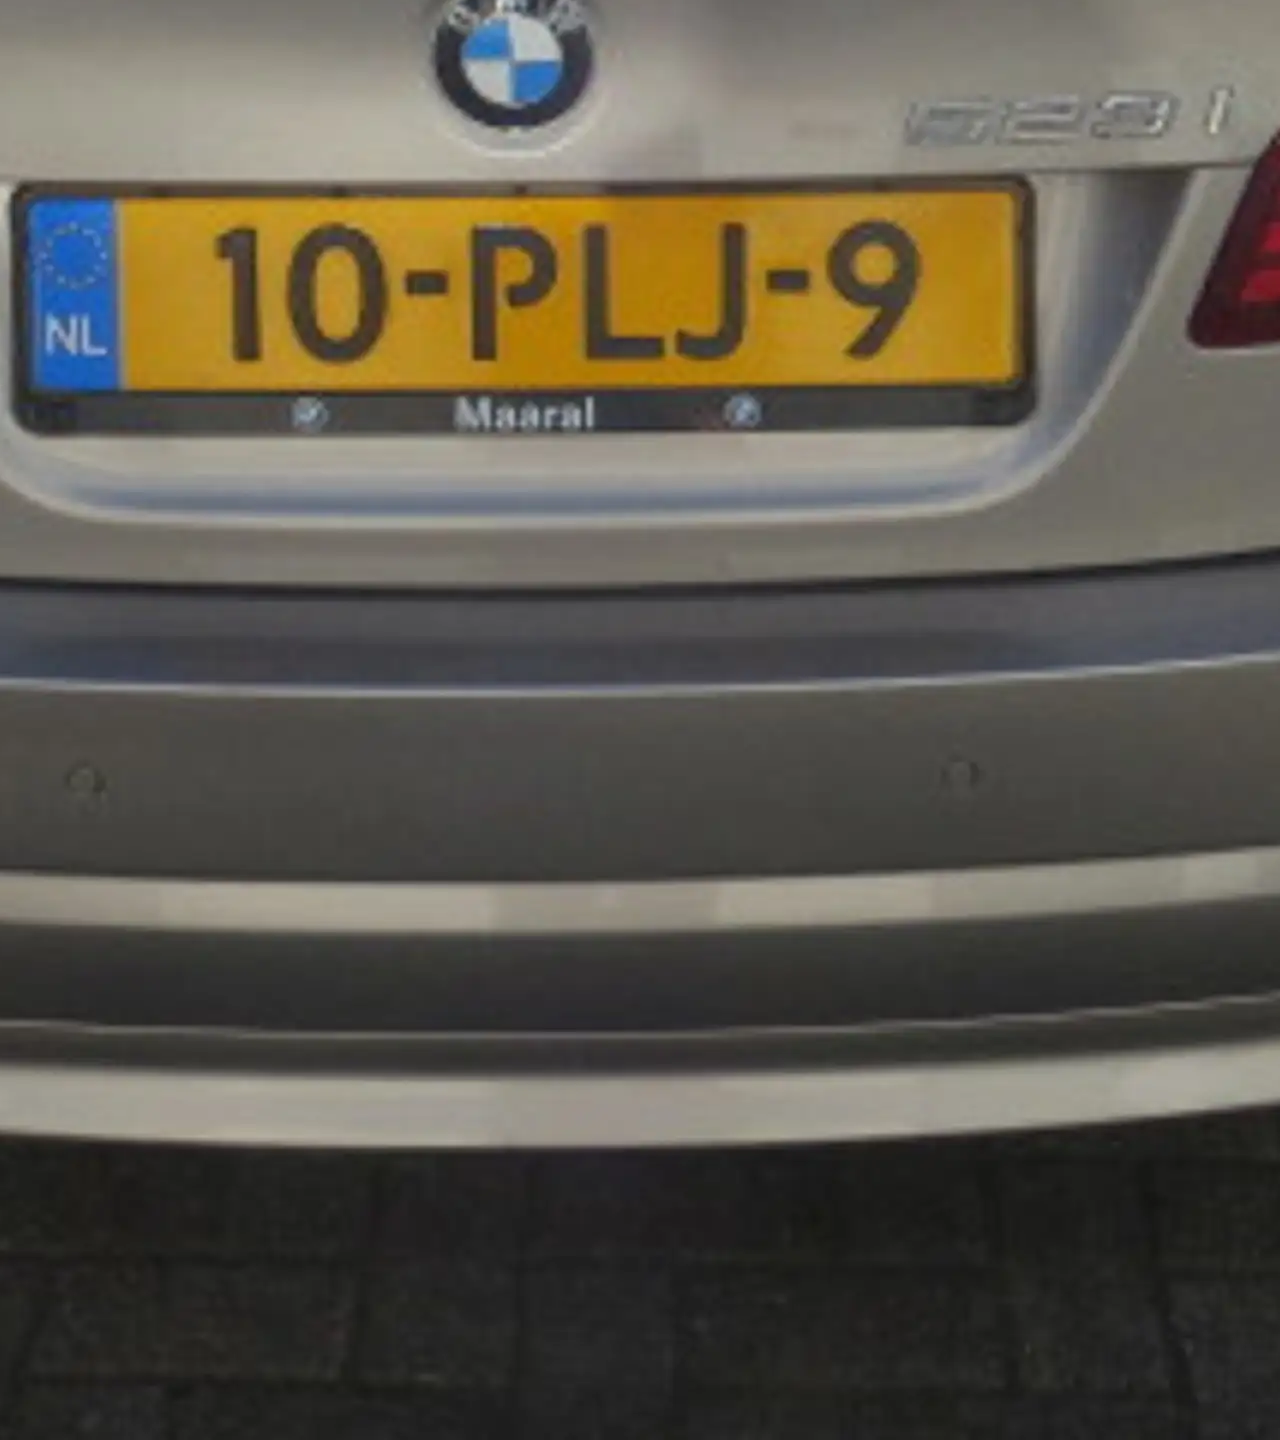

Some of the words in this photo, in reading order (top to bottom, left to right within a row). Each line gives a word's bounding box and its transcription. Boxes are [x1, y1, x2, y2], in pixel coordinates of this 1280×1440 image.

[213, 220, 923, 362] 10-PLJ-9
[45, 314, 108, 355] NL
[453, 396, 596, 431] Maaral
